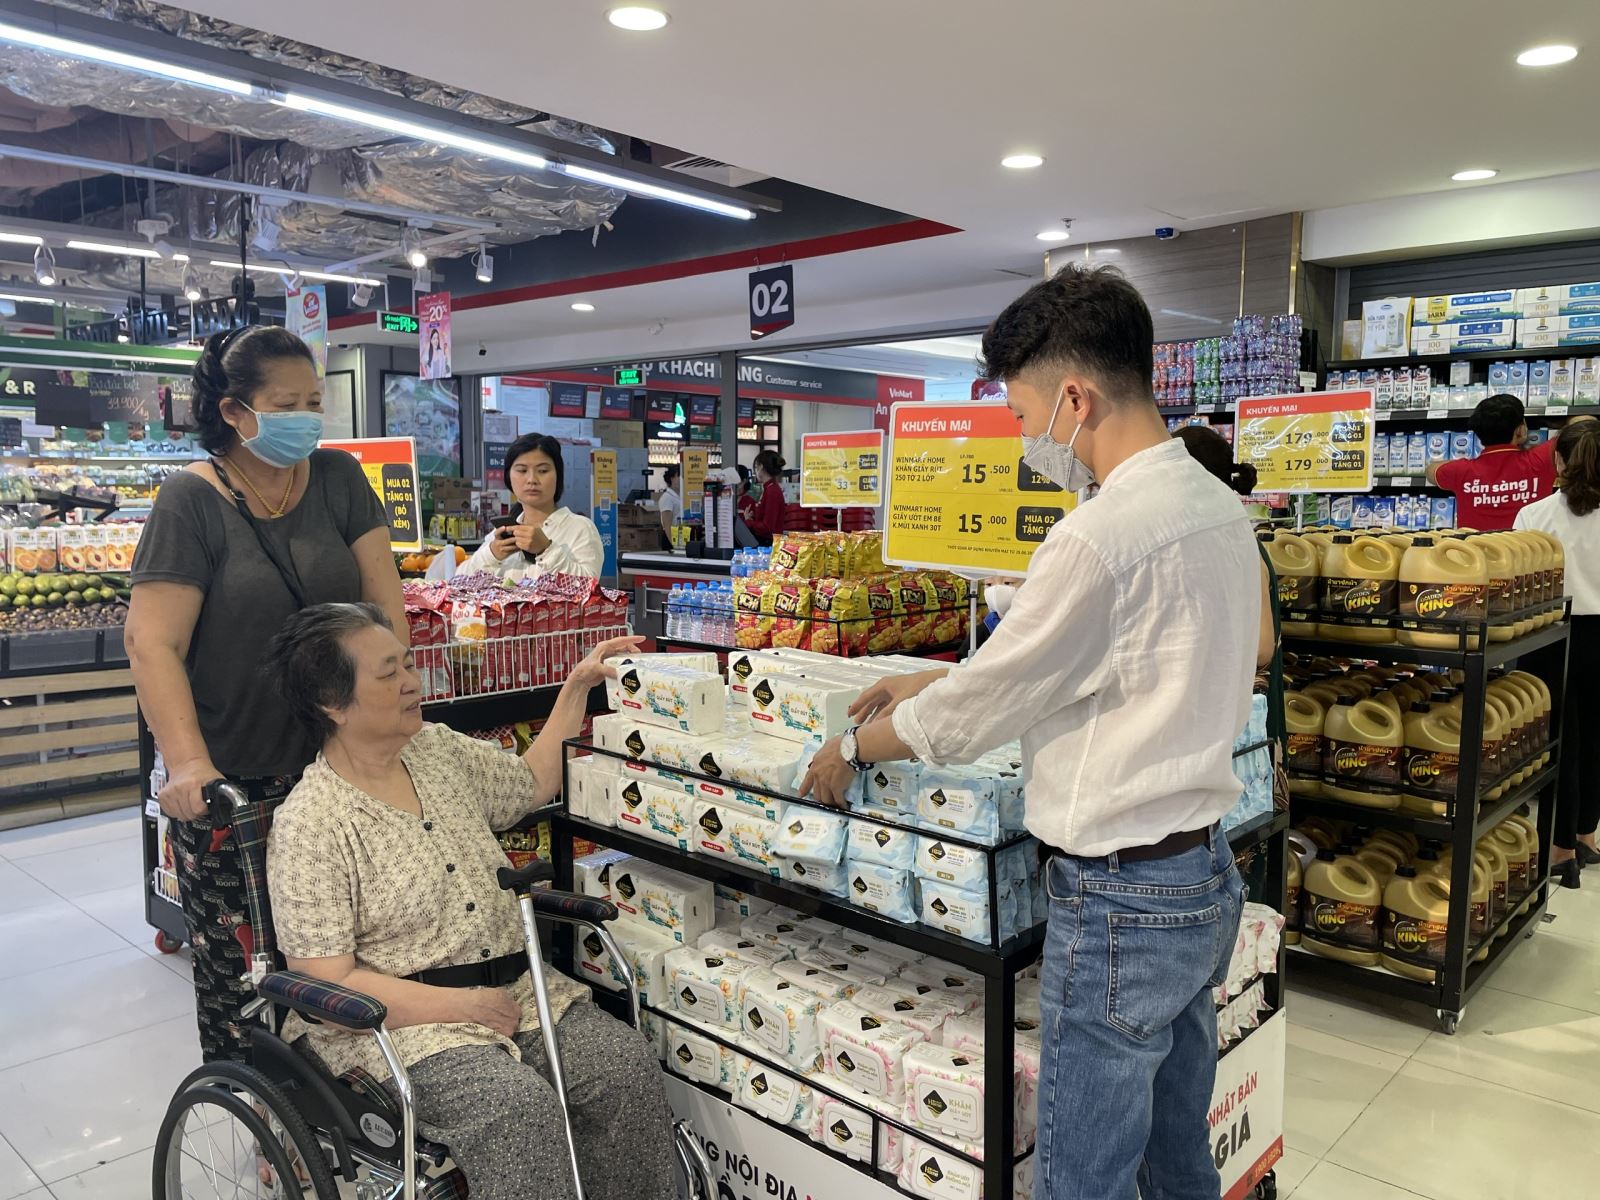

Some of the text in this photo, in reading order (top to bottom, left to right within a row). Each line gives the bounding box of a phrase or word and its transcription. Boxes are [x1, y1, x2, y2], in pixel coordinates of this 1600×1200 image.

[752, 280, 789, 317] 02
[765, 374, 797, 387] Customer
[799, 380, 822, 389] service
[901, 417, 971, 432] KHUYẾN MẠI
[1285, 459, 1312, 471] 179
[962, 463, 1010, 484] 15 .500
[386, 479, 401, 488] MUA
[401, 478, 410, 487] 02
[1463, 479, 1528, 493] Sẵn sàng
[386, 490, 404, 503] TẶNG
[404, 492, 413, 501] 01
[1473, 493, 1509, 507] phục
[893, 504, 923, 513] WINMART
[933, 514, 942, 523] BÉ
[958, 514, 1007, 534] 15 .000
[1024, 514, 1055, 524] MUA 02
[911, 523, 929, 531] XANH
[929, 524, 941, 532] 30T
[1022, 524, 1043, 536] TẶNG
[1348, 594, 1381, 610] KING
[1419, 597, 1454, 614] KING
[1337, 757, 1367, 769] KING
[1411, 765, 1440, 777] KING
[1317, 914, 1346, 925] KING
[1397, 932, 1427, 943] KING
[1208, 1071, 1258, 1128] NHẬT BẢN
[1214, 1104, 1251, 1170] GIÁ
[725, 1150, 759, 1186] NỘI
